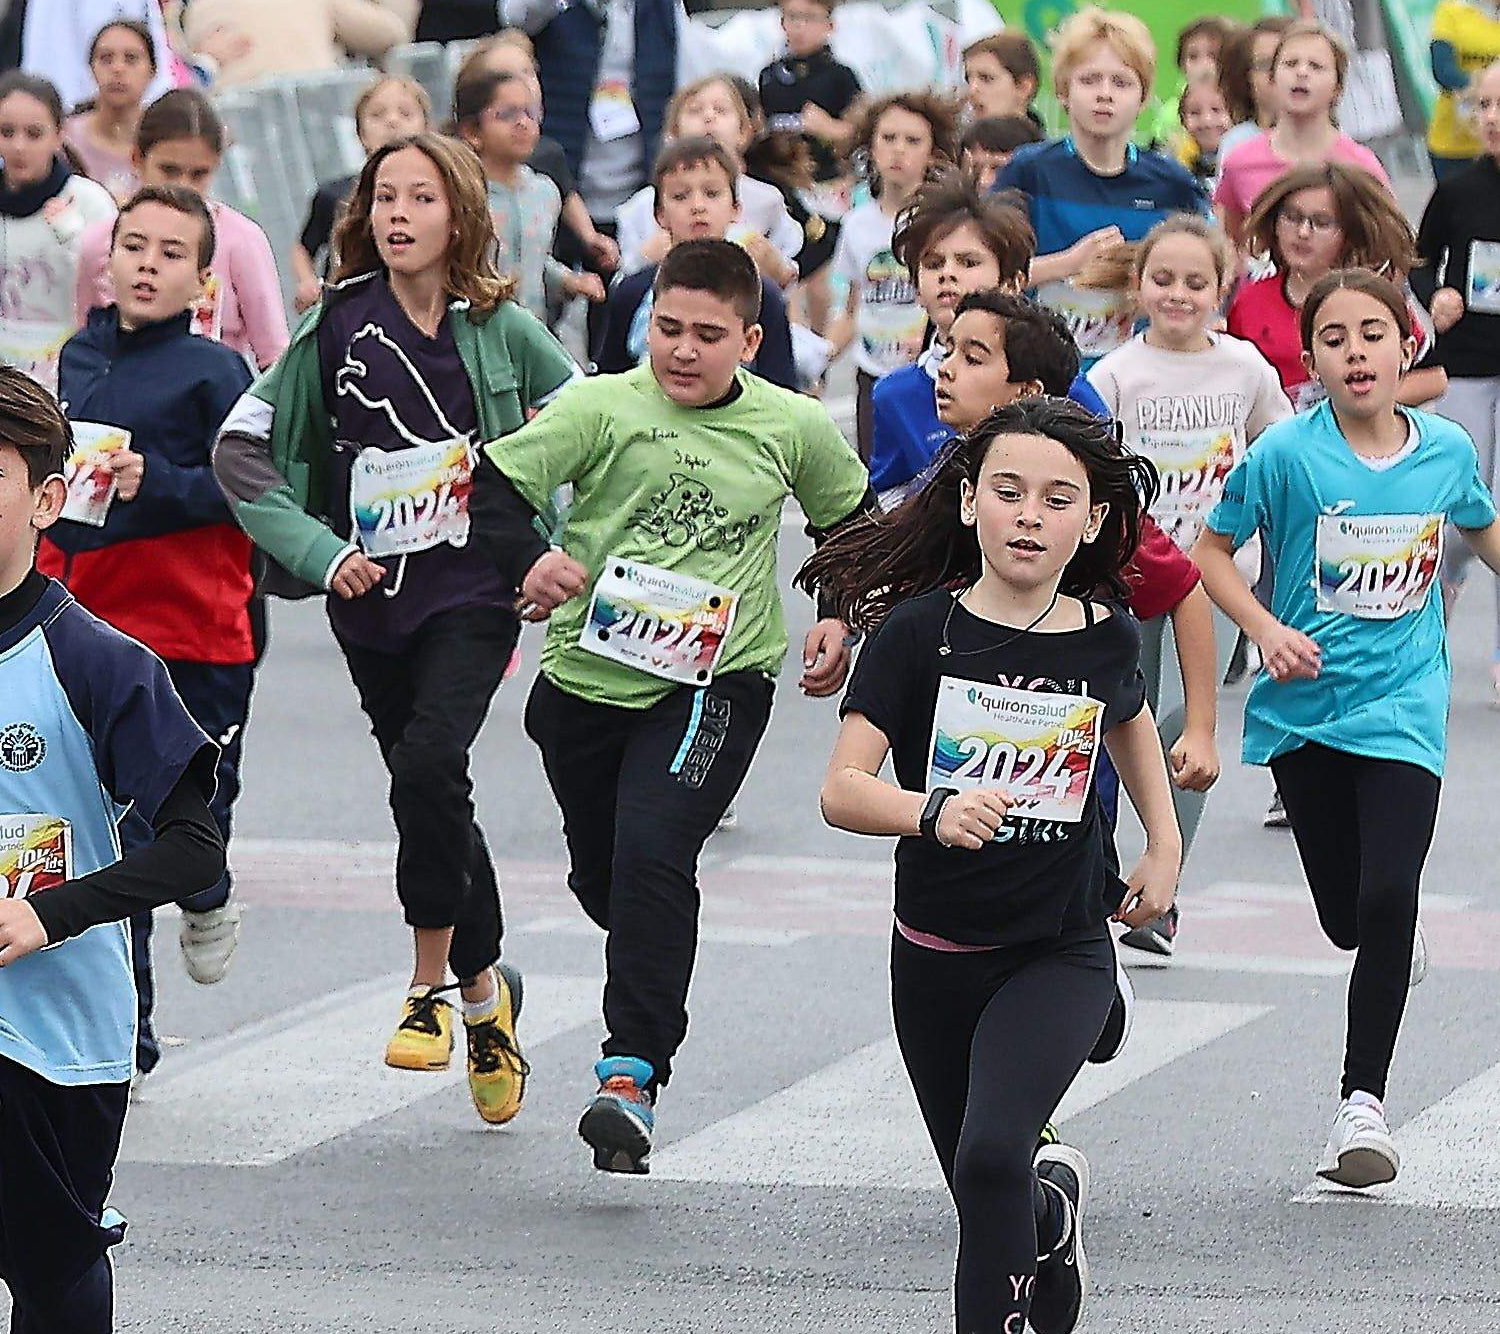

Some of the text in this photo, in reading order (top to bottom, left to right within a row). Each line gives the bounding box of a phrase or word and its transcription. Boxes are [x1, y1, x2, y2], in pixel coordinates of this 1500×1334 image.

[367, 483, 461, 536] 2024
[1335, 557, 1425, 597] 2024
[611, 608, 711, 663] 2024
[981, 695, 1067, 718] quirónsalud
[950, 736, 1072, 799] 2024
